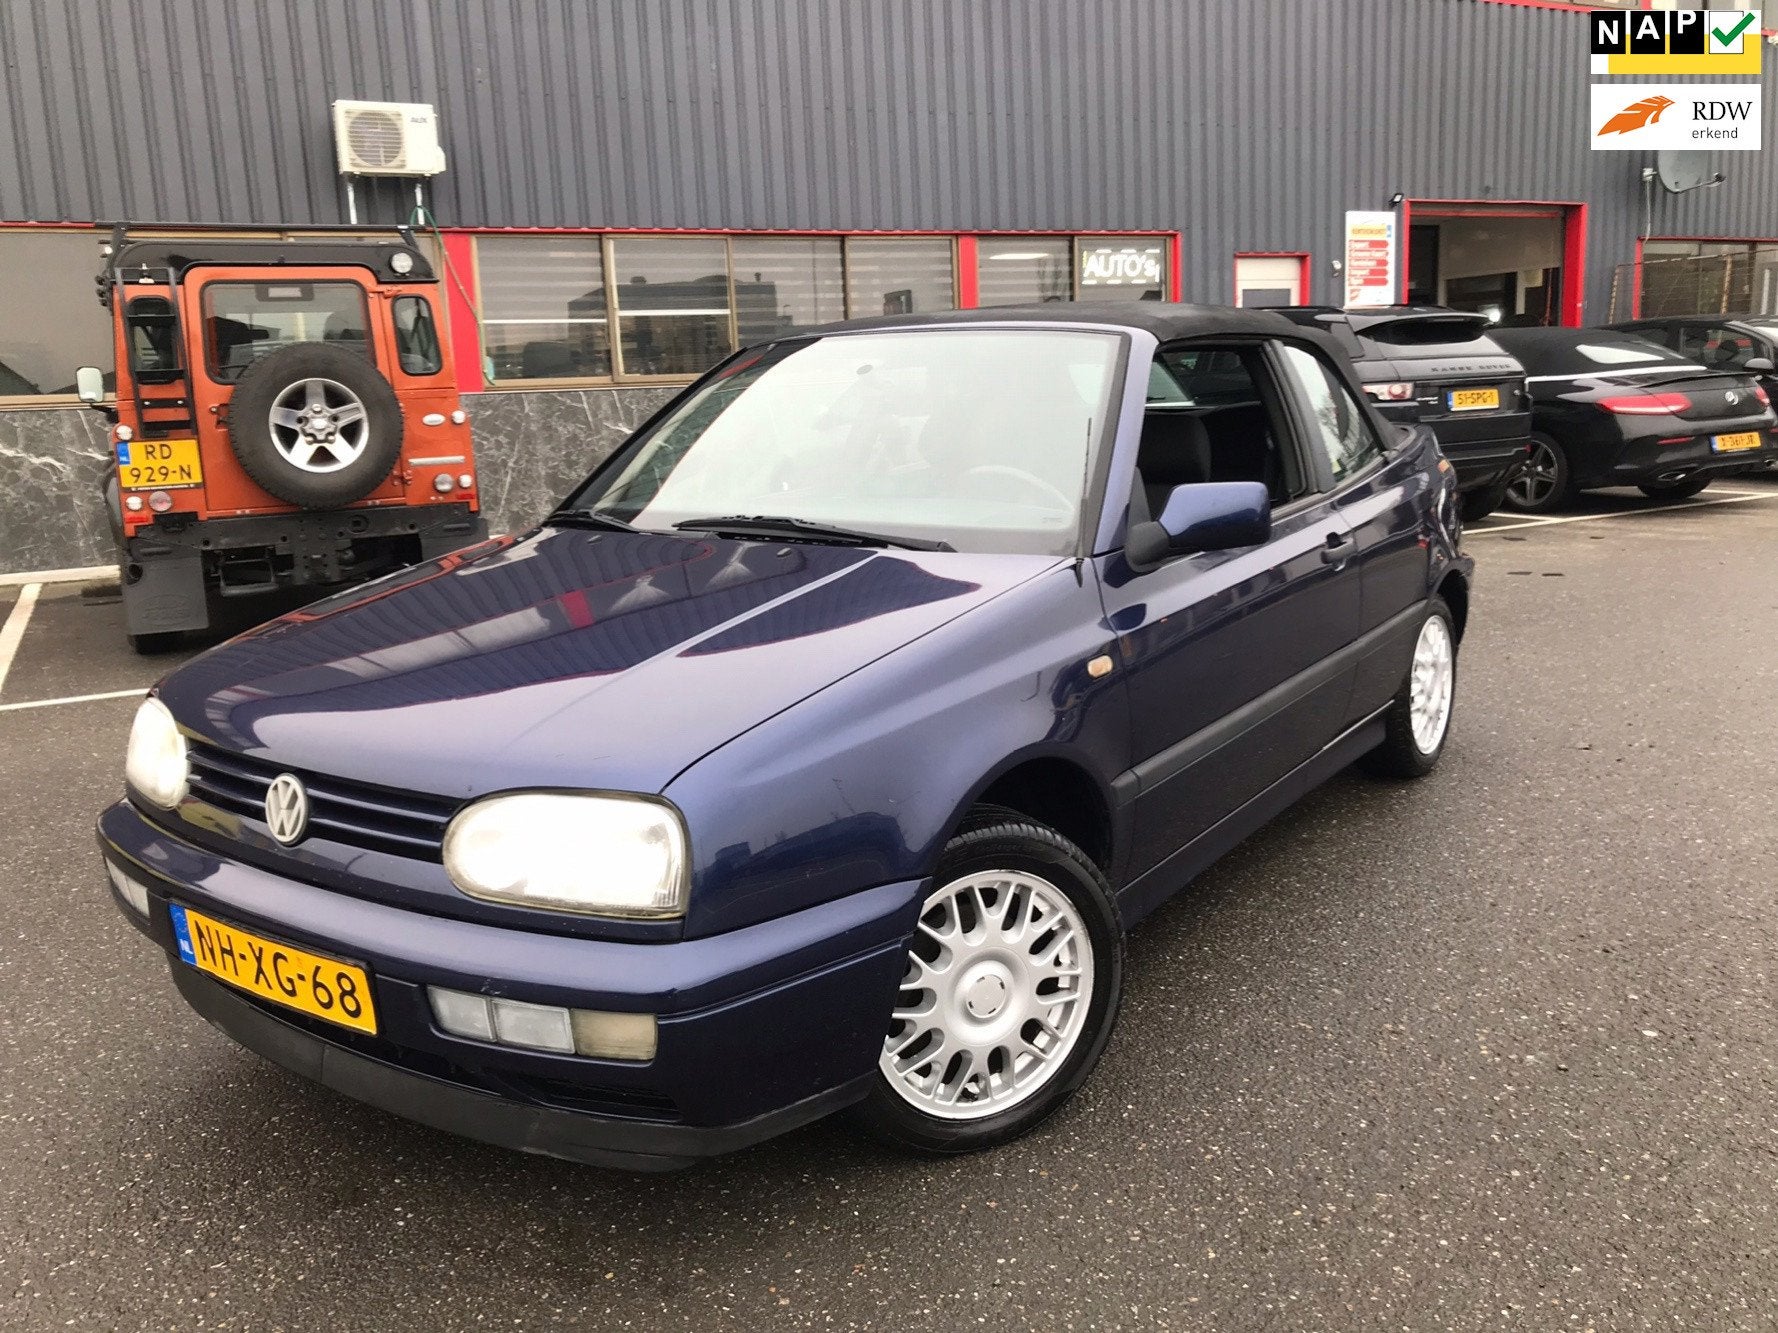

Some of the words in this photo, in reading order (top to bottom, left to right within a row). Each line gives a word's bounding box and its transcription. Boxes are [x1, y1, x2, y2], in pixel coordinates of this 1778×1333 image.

[144, 443, 172, 460] RD
[130, 464, 192, 484] 929-N
[194, 919, 363, 1019] NH-XG-68
